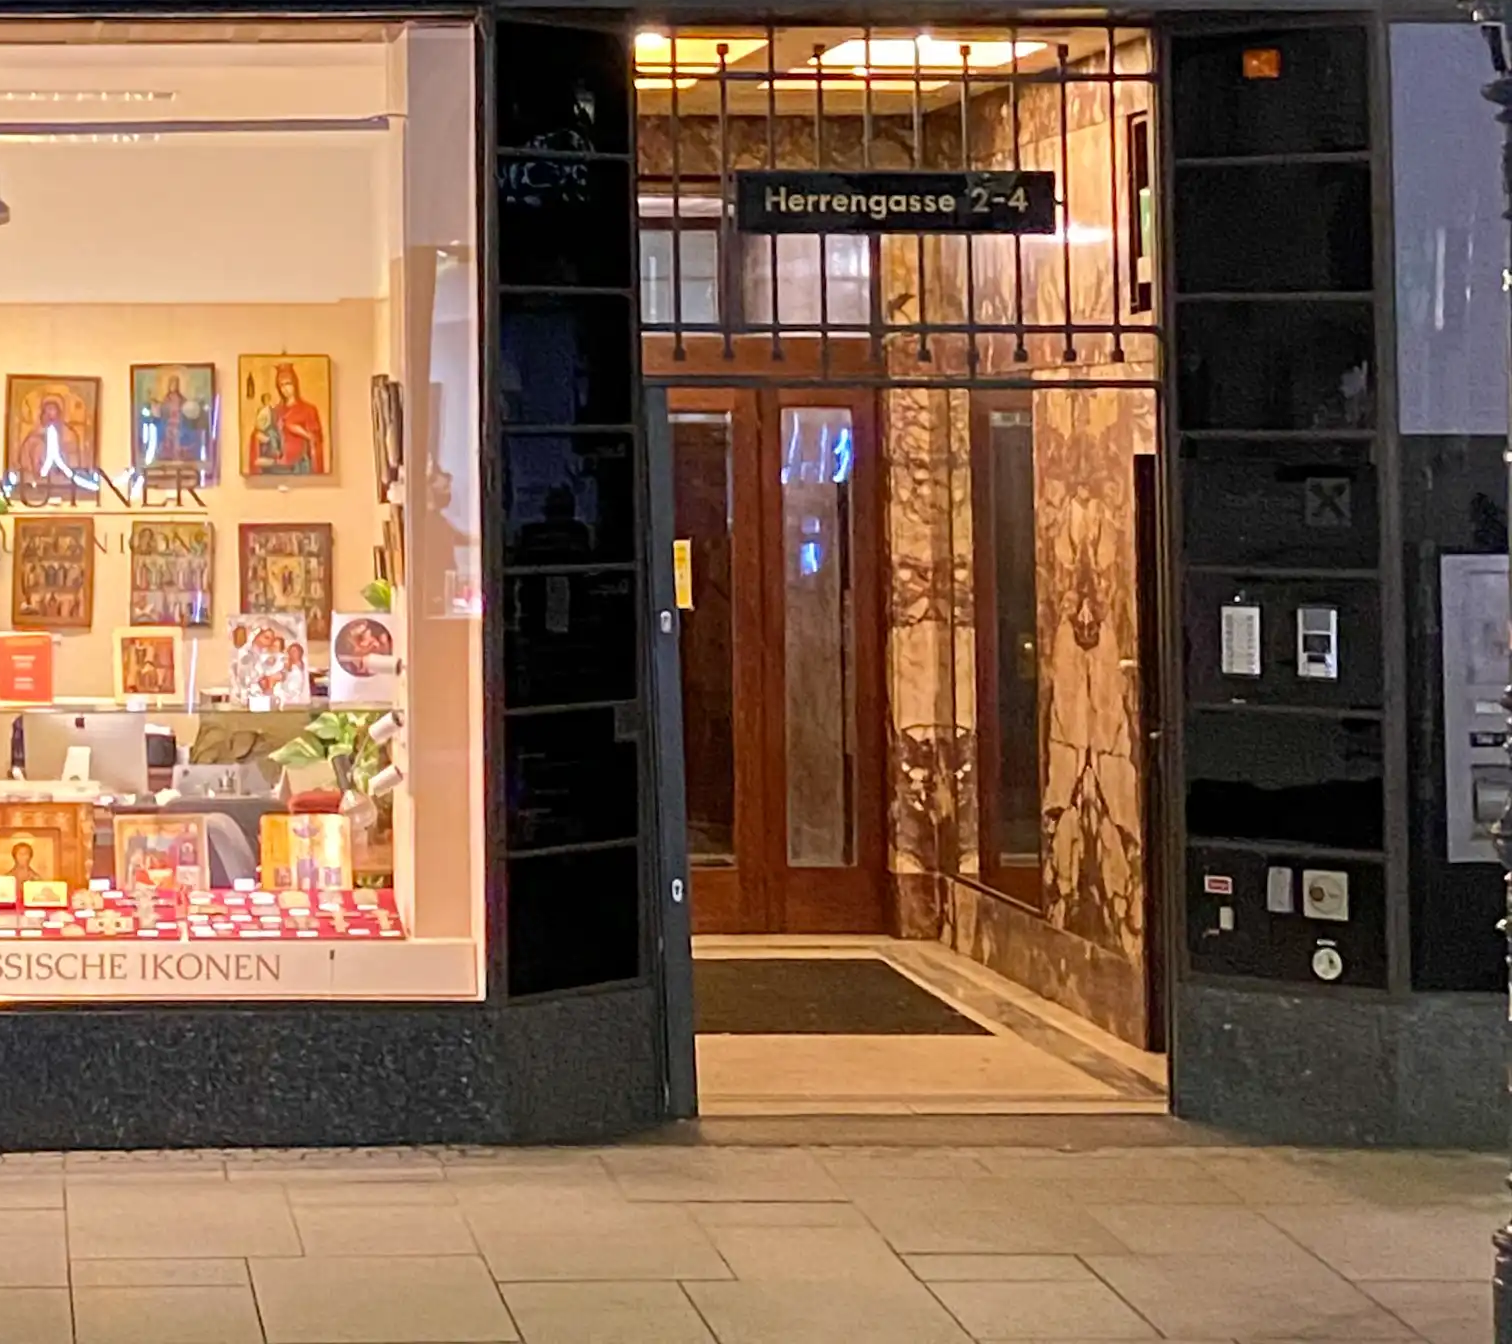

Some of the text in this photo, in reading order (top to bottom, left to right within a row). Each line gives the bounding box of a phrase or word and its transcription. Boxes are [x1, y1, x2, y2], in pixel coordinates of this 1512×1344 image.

[764, 186, 1029, 219] Herrengasse 2-4
[140, 953, 281, 981] IKONEN
